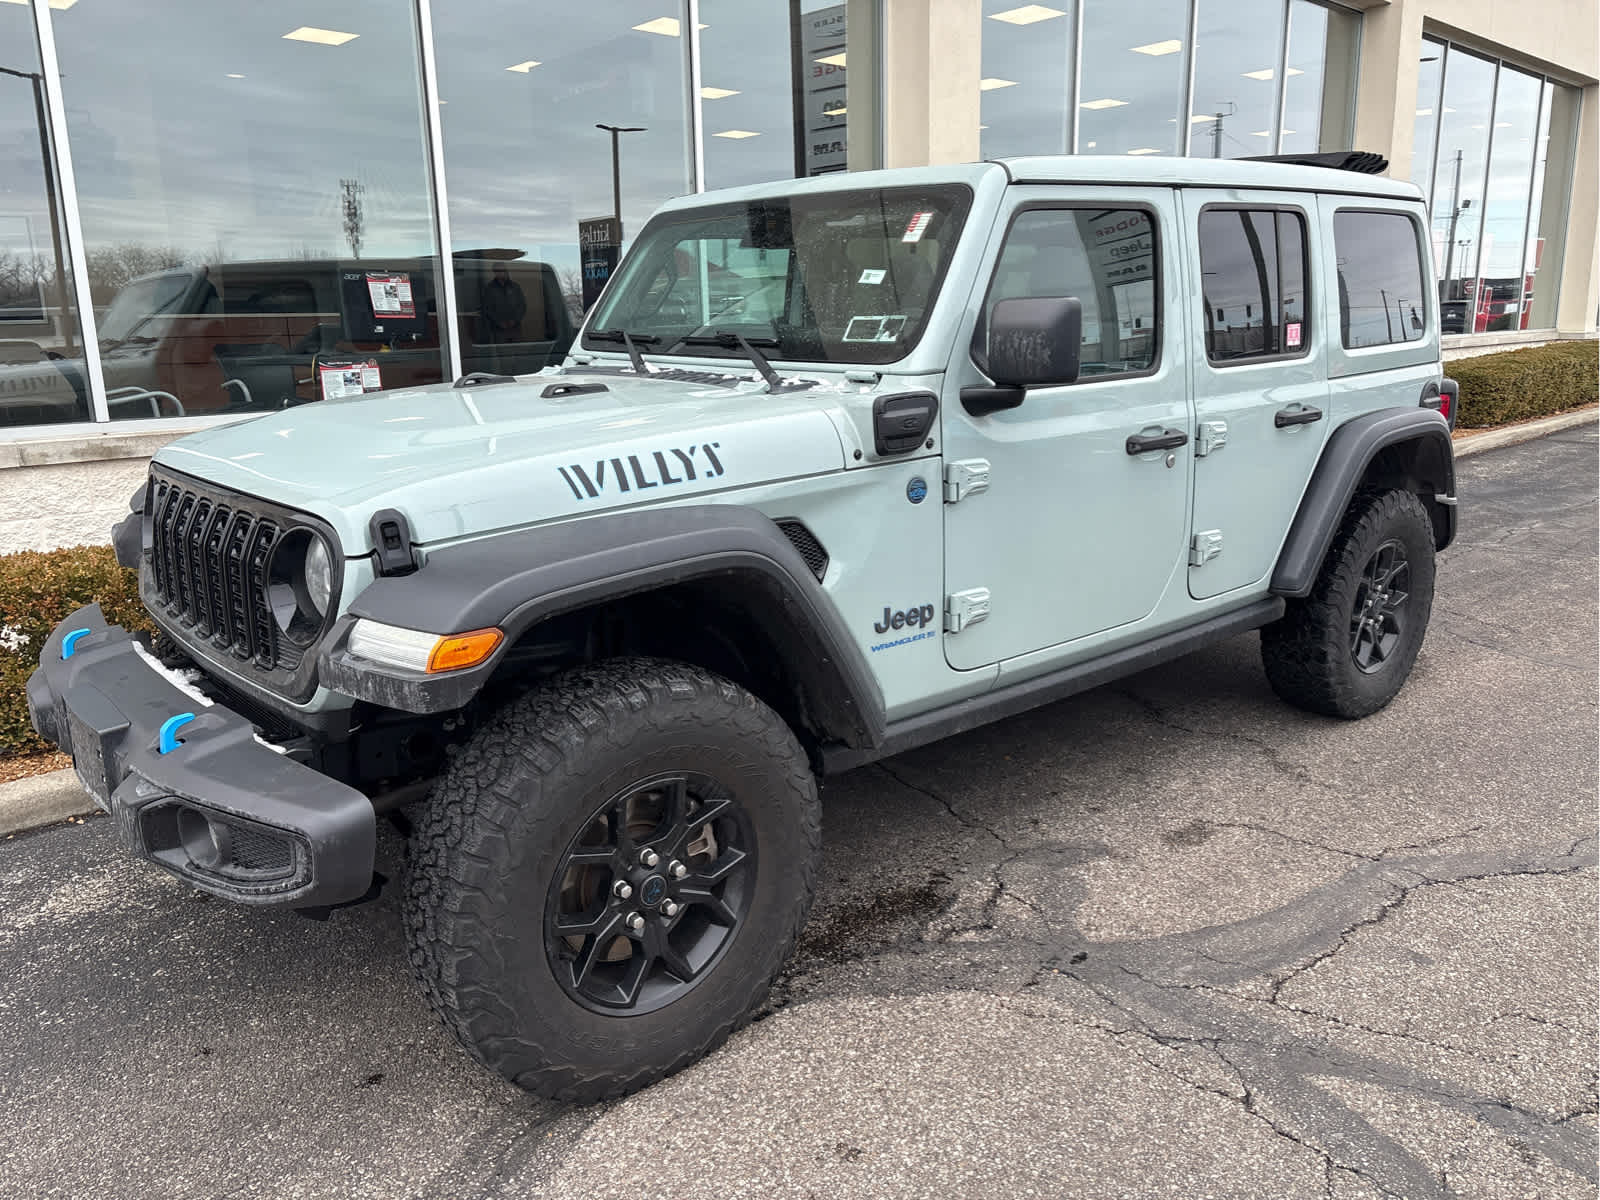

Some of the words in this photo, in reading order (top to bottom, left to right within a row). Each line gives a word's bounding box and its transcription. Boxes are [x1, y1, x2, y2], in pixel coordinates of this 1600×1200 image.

[557, 442, 724, 500] WILLYS
[874, 604, 934, 634] Jeep
[871, 633, 925, 652] WRANGLER
